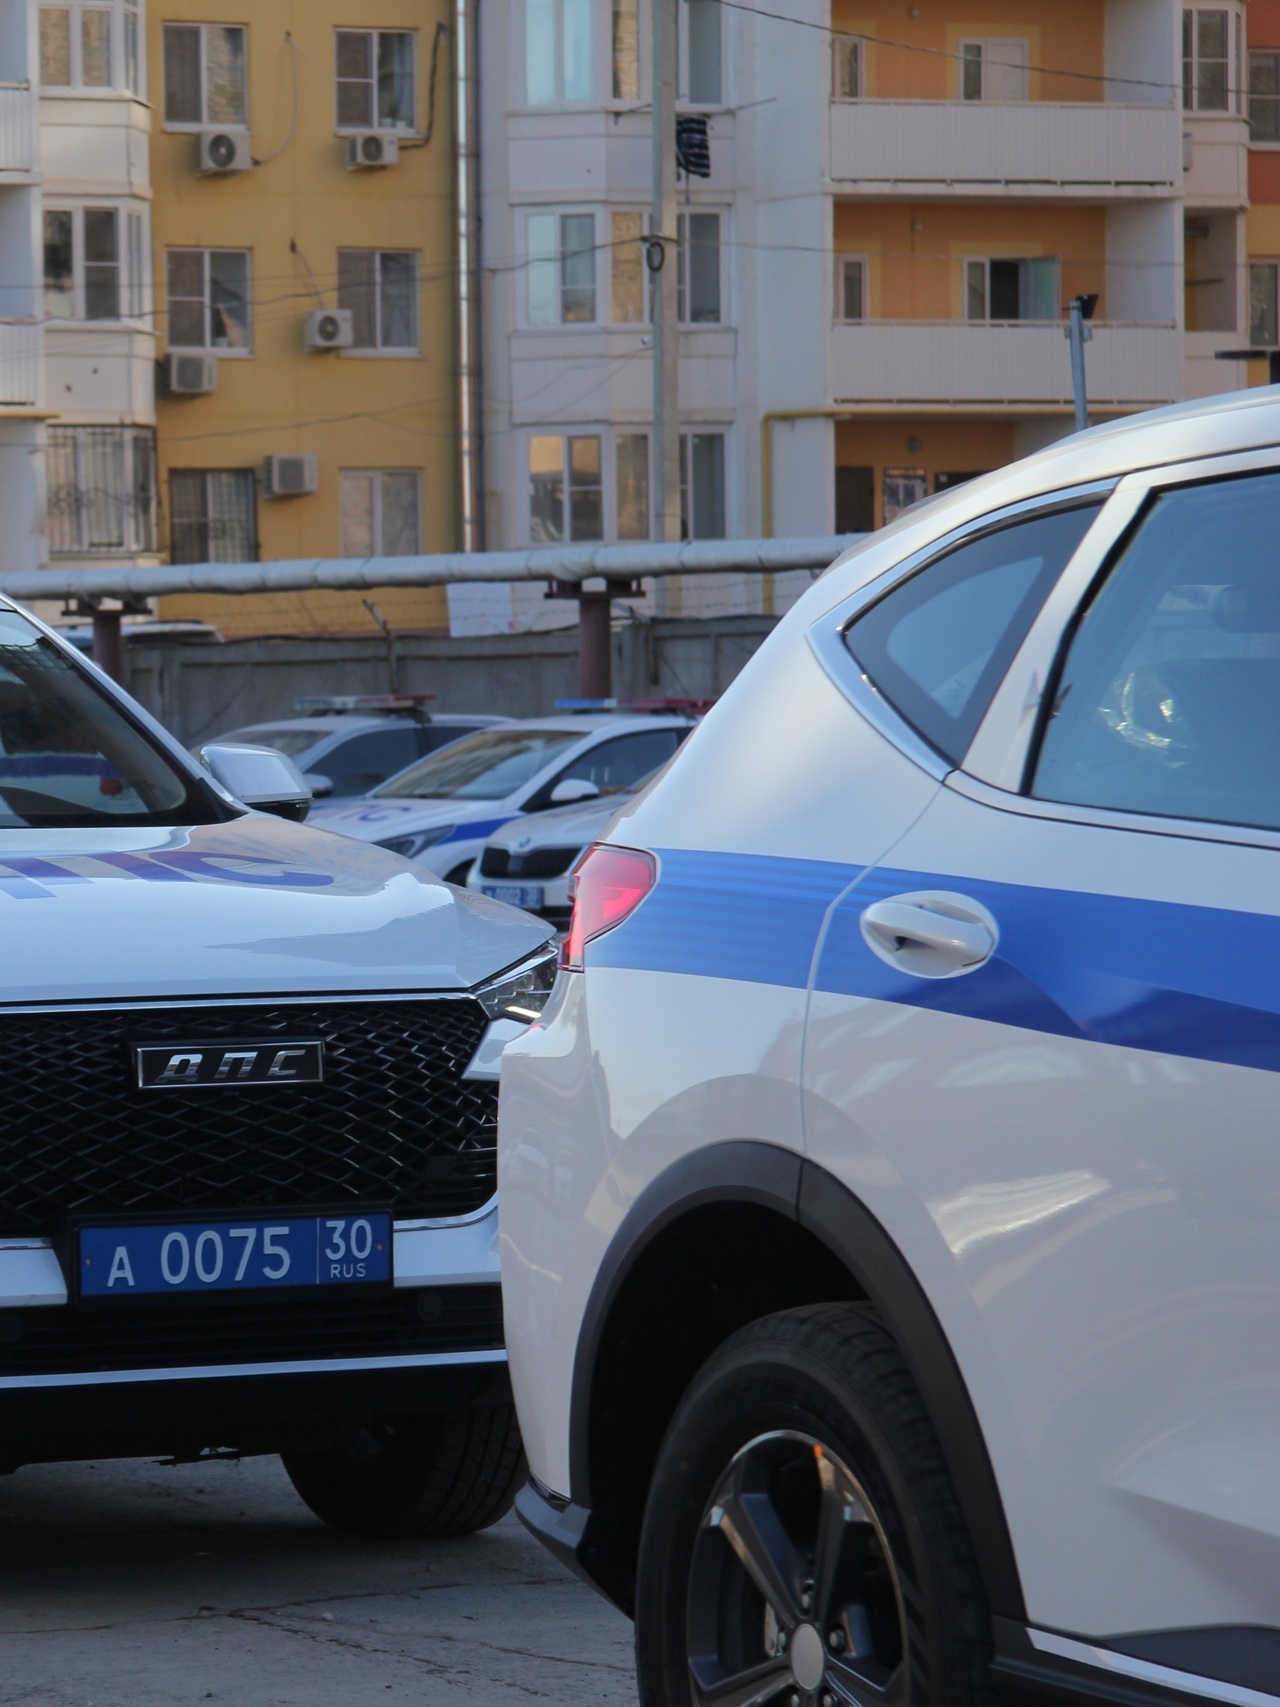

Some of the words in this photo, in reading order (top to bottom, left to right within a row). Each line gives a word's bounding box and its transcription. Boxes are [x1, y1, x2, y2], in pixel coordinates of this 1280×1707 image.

[155, 1049, 306, 1083] ДПС
[160, 1226, 291, 1285] 0075
[325, 1218, 373, 1261] 30
[330, 1262, 367, 1279] RUS
